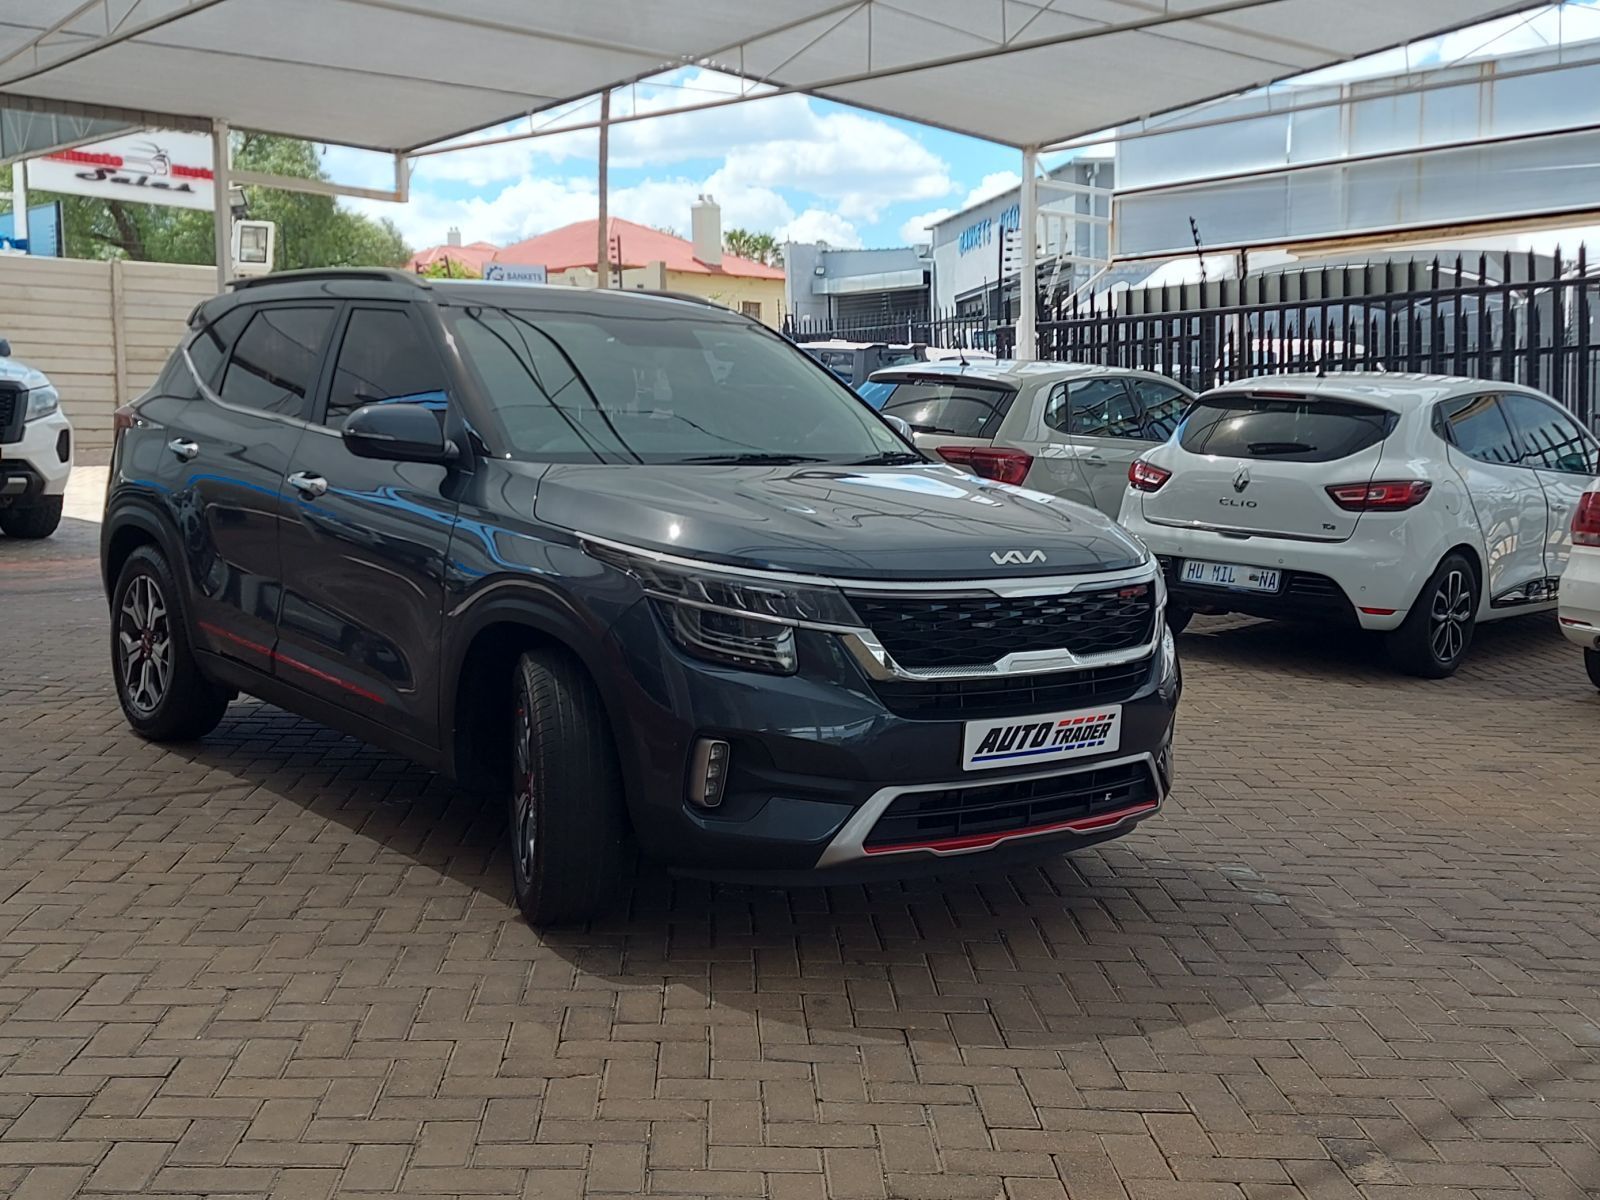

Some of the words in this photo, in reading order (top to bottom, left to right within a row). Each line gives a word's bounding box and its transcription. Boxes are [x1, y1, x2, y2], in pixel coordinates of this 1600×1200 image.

[1219, 497, 1258, 509] CLIO
[989, 548, 1048, 566] KIA
[974, 721, 1055, 755] AUTO
[1051, 721, 1113, 747] TRADER
